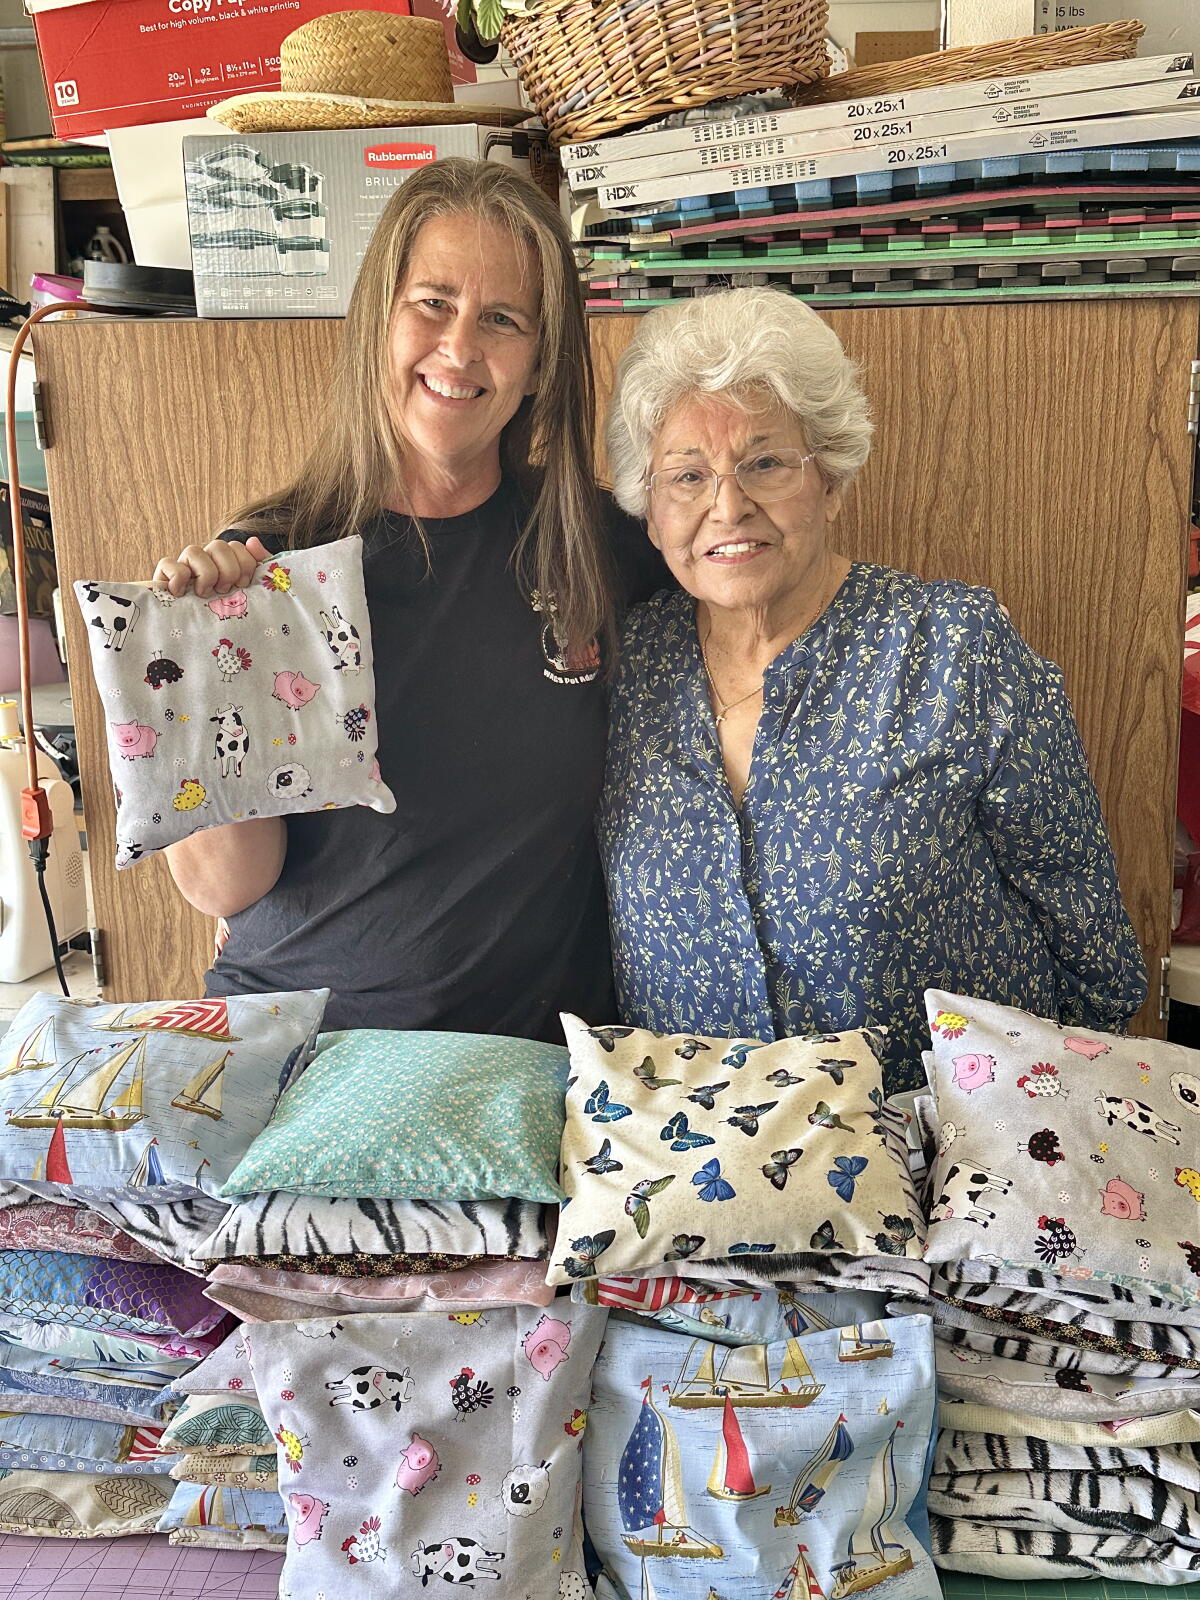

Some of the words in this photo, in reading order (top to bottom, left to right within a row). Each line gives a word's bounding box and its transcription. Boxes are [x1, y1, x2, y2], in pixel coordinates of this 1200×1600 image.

[168, 0, 212, 13] Copy
[1069, 6, 1085, 16] lbs
[140, 24, 157, 33] Best
[158, 22, 169, 31] for
[170, 19, 187, 29] high
[188, 15, 218, 25] volume,
[219, 11, 239, 20] black
[241, 9, 247, 17] &
[247, 6, 269, 15] white
[269, 1, 300, 12] printing
[265, 57, 281, 66] 500
[200, 68, 211, 76] 92
[195, 76, 219, 84] Brightness
[57, 84, 75, 99] 10
[181, 100, 218, 109] ENGINEERED
[368, 151, 433, 162] Rubbermaid
[569, 143, 600, 161] HDX
[576, 166, 605, 183] HDX
[365, 176, 404, 186] BRILLI
[604, 185, 637, 201] HDX
[24, 527, 54, 553] AVOC
